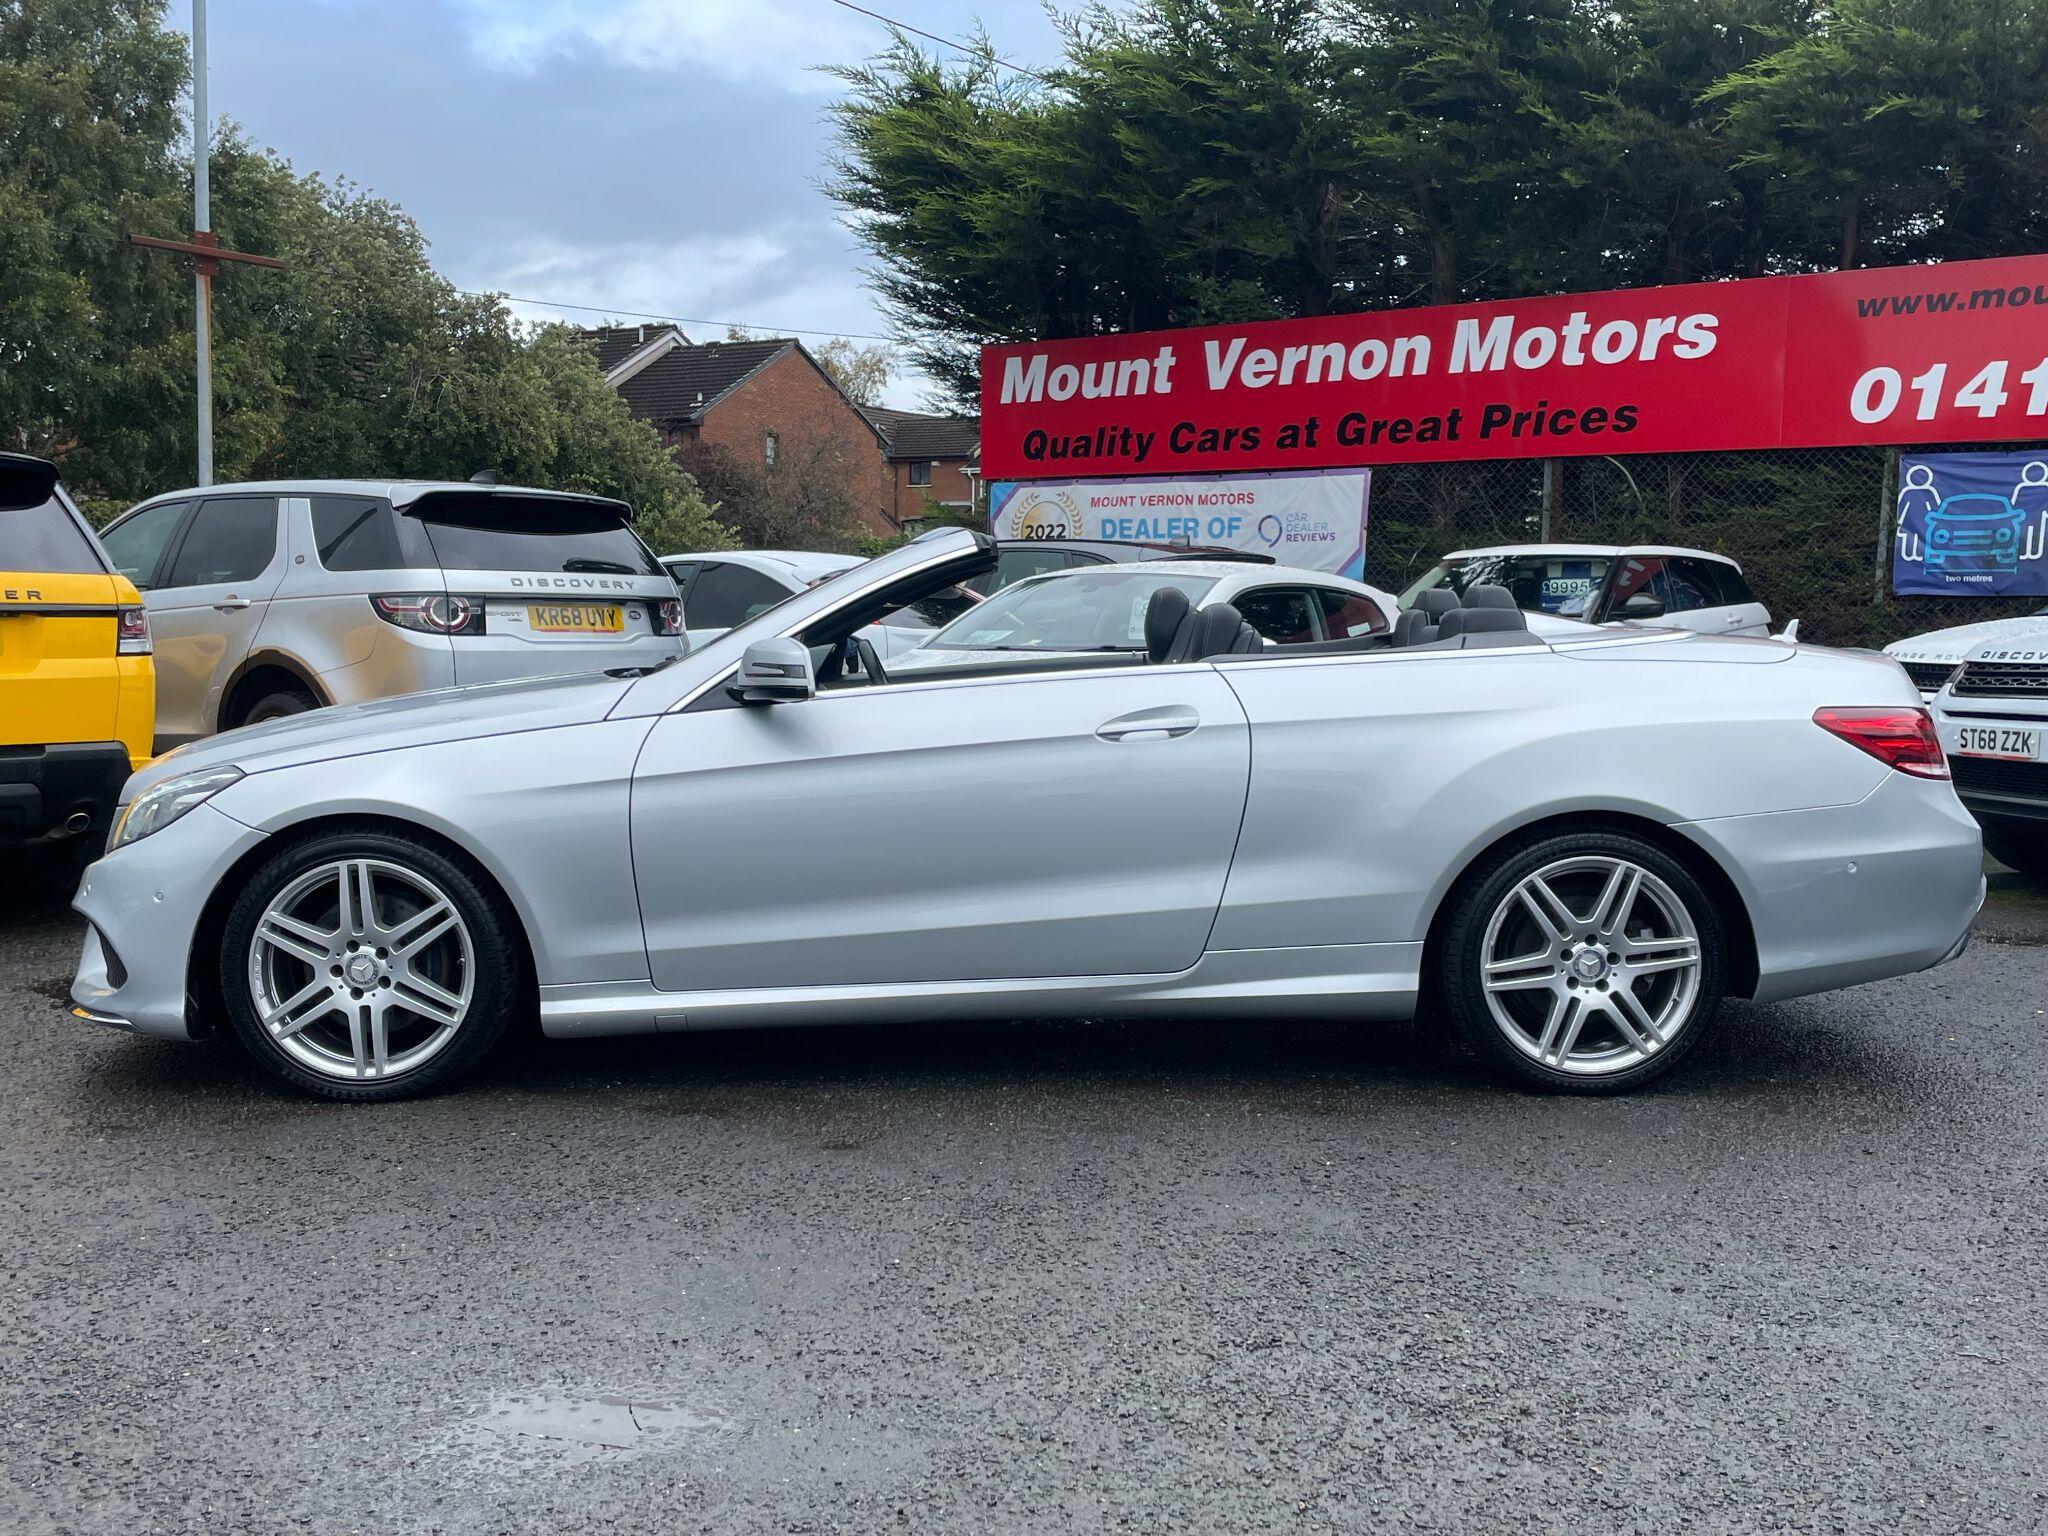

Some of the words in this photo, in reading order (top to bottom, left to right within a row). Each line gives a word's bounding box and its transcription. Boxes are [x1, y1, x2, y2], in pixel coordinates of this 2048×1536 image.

[1000, 345, 1177, 405] Mount
[1204, 337, 1432, 391] Vernon
[1448, 311, 1719, 374] Motors
[1850, 357, 2048, 424] 0141
[1022, 425, 1156, 463] Quality
[1169, 421, 1261, 455] Cars
[1275, 416, 1320, 449] at
[1336, 408, 1463, 446] Great
[1479, 400, 1639, 439] Prices
[1090, 496, 1136, 508] MOUNT
[1140, 494, 1194, 507] VERNON
[1198, 492, 1255, 505] MOTORS
[1286, 513, 1309, 523] CAR
[1024, 523, 1067, 540] 2022
[1101, 516, 1200, 540] DEALER
[1207, 516, 1243, 540] OF
[1286, 522, 1329, 533] DEALER
[1286, 531, 1336, 542] REVIEWS
[511, 577, 635, 590] DISCOVERY
[1963, 574, 1993, 582] metres
[535, 607, 583, 627] KR68
[587, 607, 617, 627] UVY
[1980, 651, 2048, 660] DISCOV
[1960, 728, 1997, 751] ST68
[2000, 730, 2032, 754] ZZK
